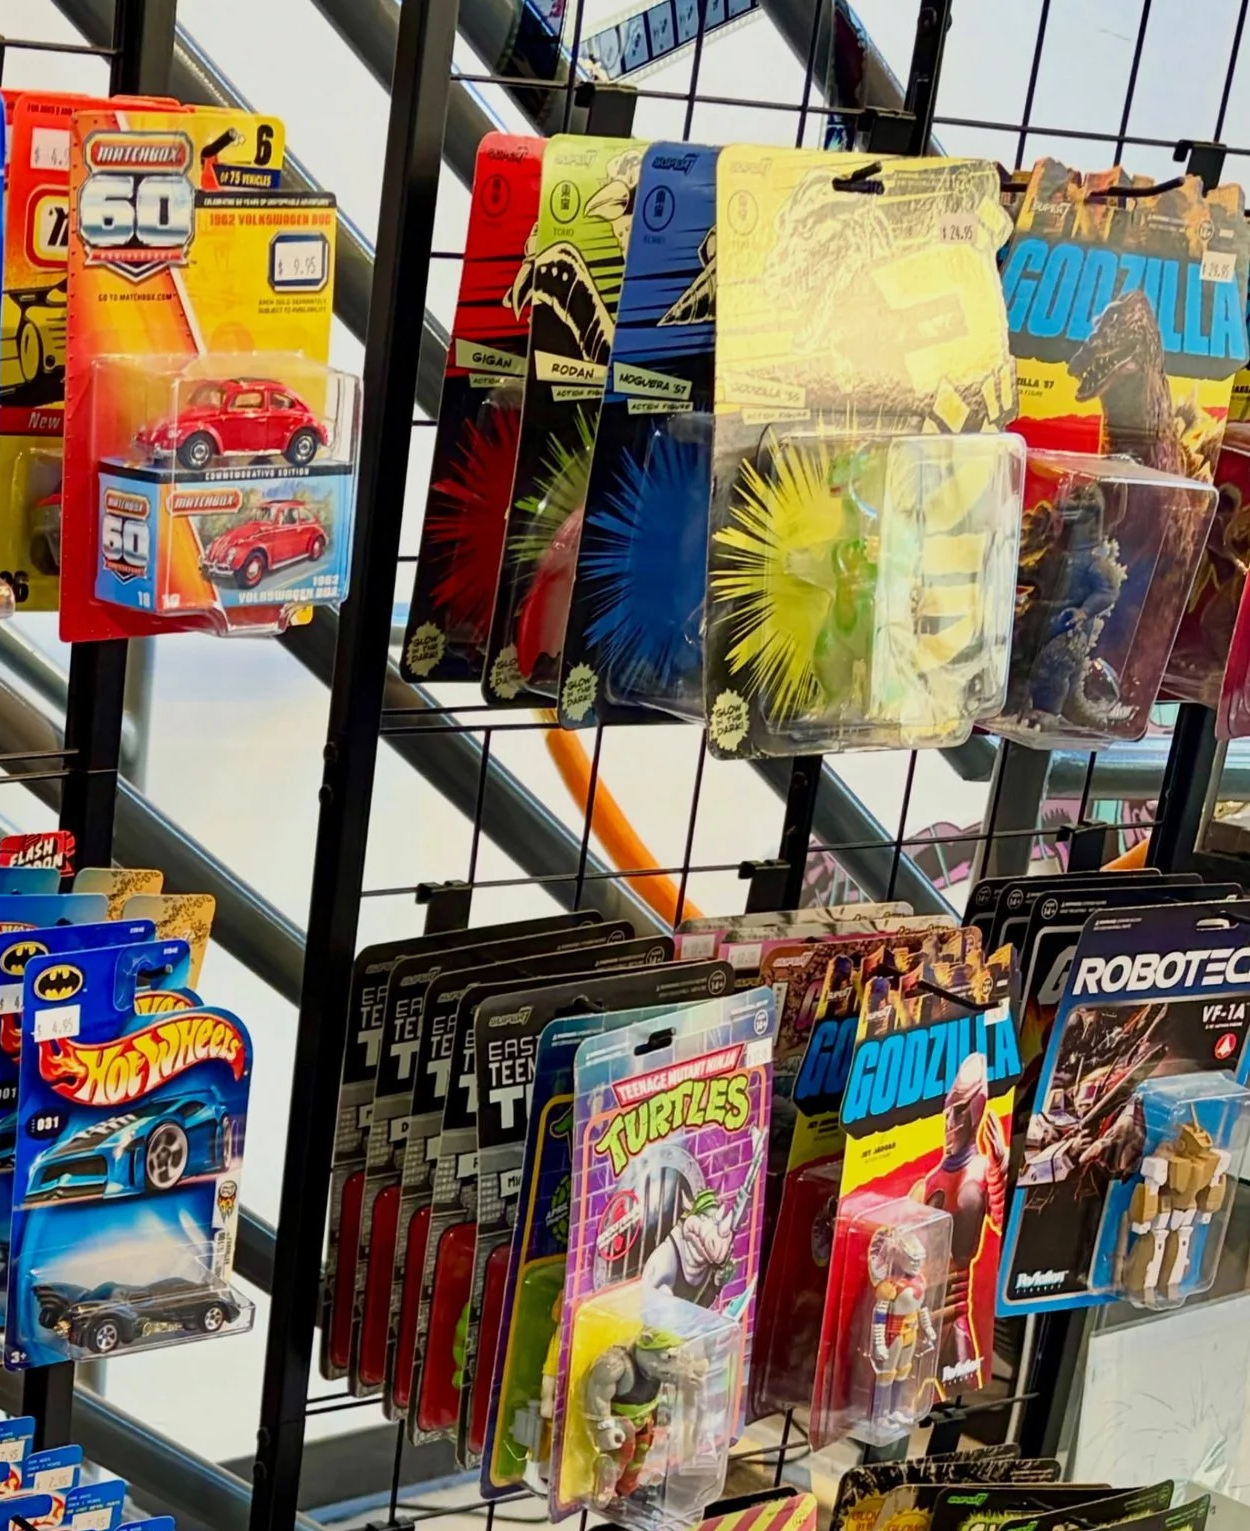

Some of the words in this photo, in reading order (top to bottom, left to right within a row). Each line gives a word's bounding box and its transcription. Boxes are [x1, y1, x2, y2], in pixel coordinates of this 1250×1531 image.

[96, 144, 183, 164] MATCHBOX
[253, 124, 274, 167] 6
[220, 172, 229, 185] OF
[230, 170, 242, 185] 75
[242, 174, 272, 187] VEHICLES
[80, 175, 195, 249] 60
[471, 351, 513, 370] GIGAN
[551, 363, 596, 380] RODAN
[619, 372, 671, 393] MOGUERA
[27, 411, 61, 430] New
[205, 470, 274, 481] COMMEMORATIVE
[277, 468, 309, 477] EDITION
[173, 493, 236, 510] MATCHBOX
[9, 837, 55, 870] FLASH
[1202, 1003, 1245, 1023] VF-1A
[840, 1003, 1023, 1125] GODZILLA
[617, 1073, 667, 1102] TEENAGE
[666, 1061, 707, 1088] MUTANT
[706, 1047, 741, 1075] NINJA
[594, 1073, 752, 1178] TURTLES
